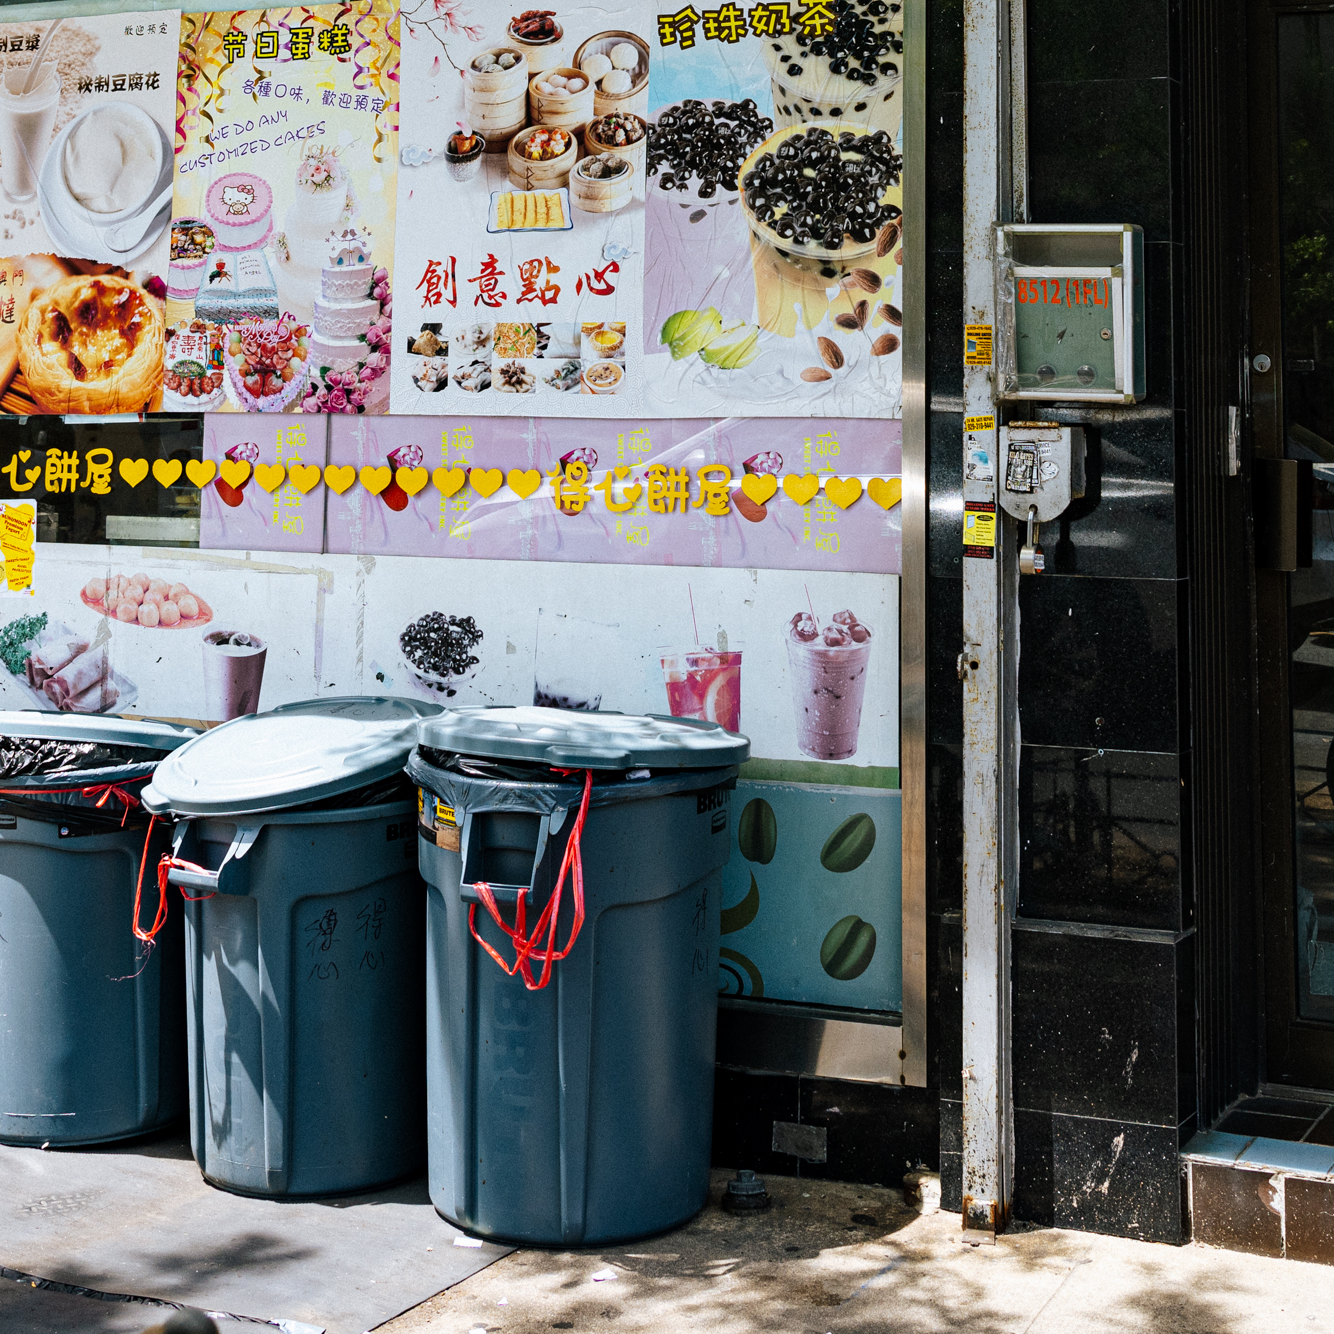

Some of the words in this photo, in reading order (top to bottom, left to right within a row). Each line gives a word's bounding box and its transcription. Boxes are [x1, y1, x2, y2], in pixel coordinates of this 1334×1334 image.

[223, 23, 352, 64] 节日蛋糕
[209, 125, 229, 142] WE
[233, 120, 254, 135] DO
[259, 110, 288, 127] ANY
[179, 139, 270, 174] CUSTOMIZED
[274, 121, 326, 147] CAKES
[415, 253, 620, 309] 創意點心
[1017, 278, 1062, 305] 8512
[1065, 278, 1109, 309] (1FL)
[546, 460, 732, 515] 得心餅屋
[439, 807, 455, 818] BRUTE
